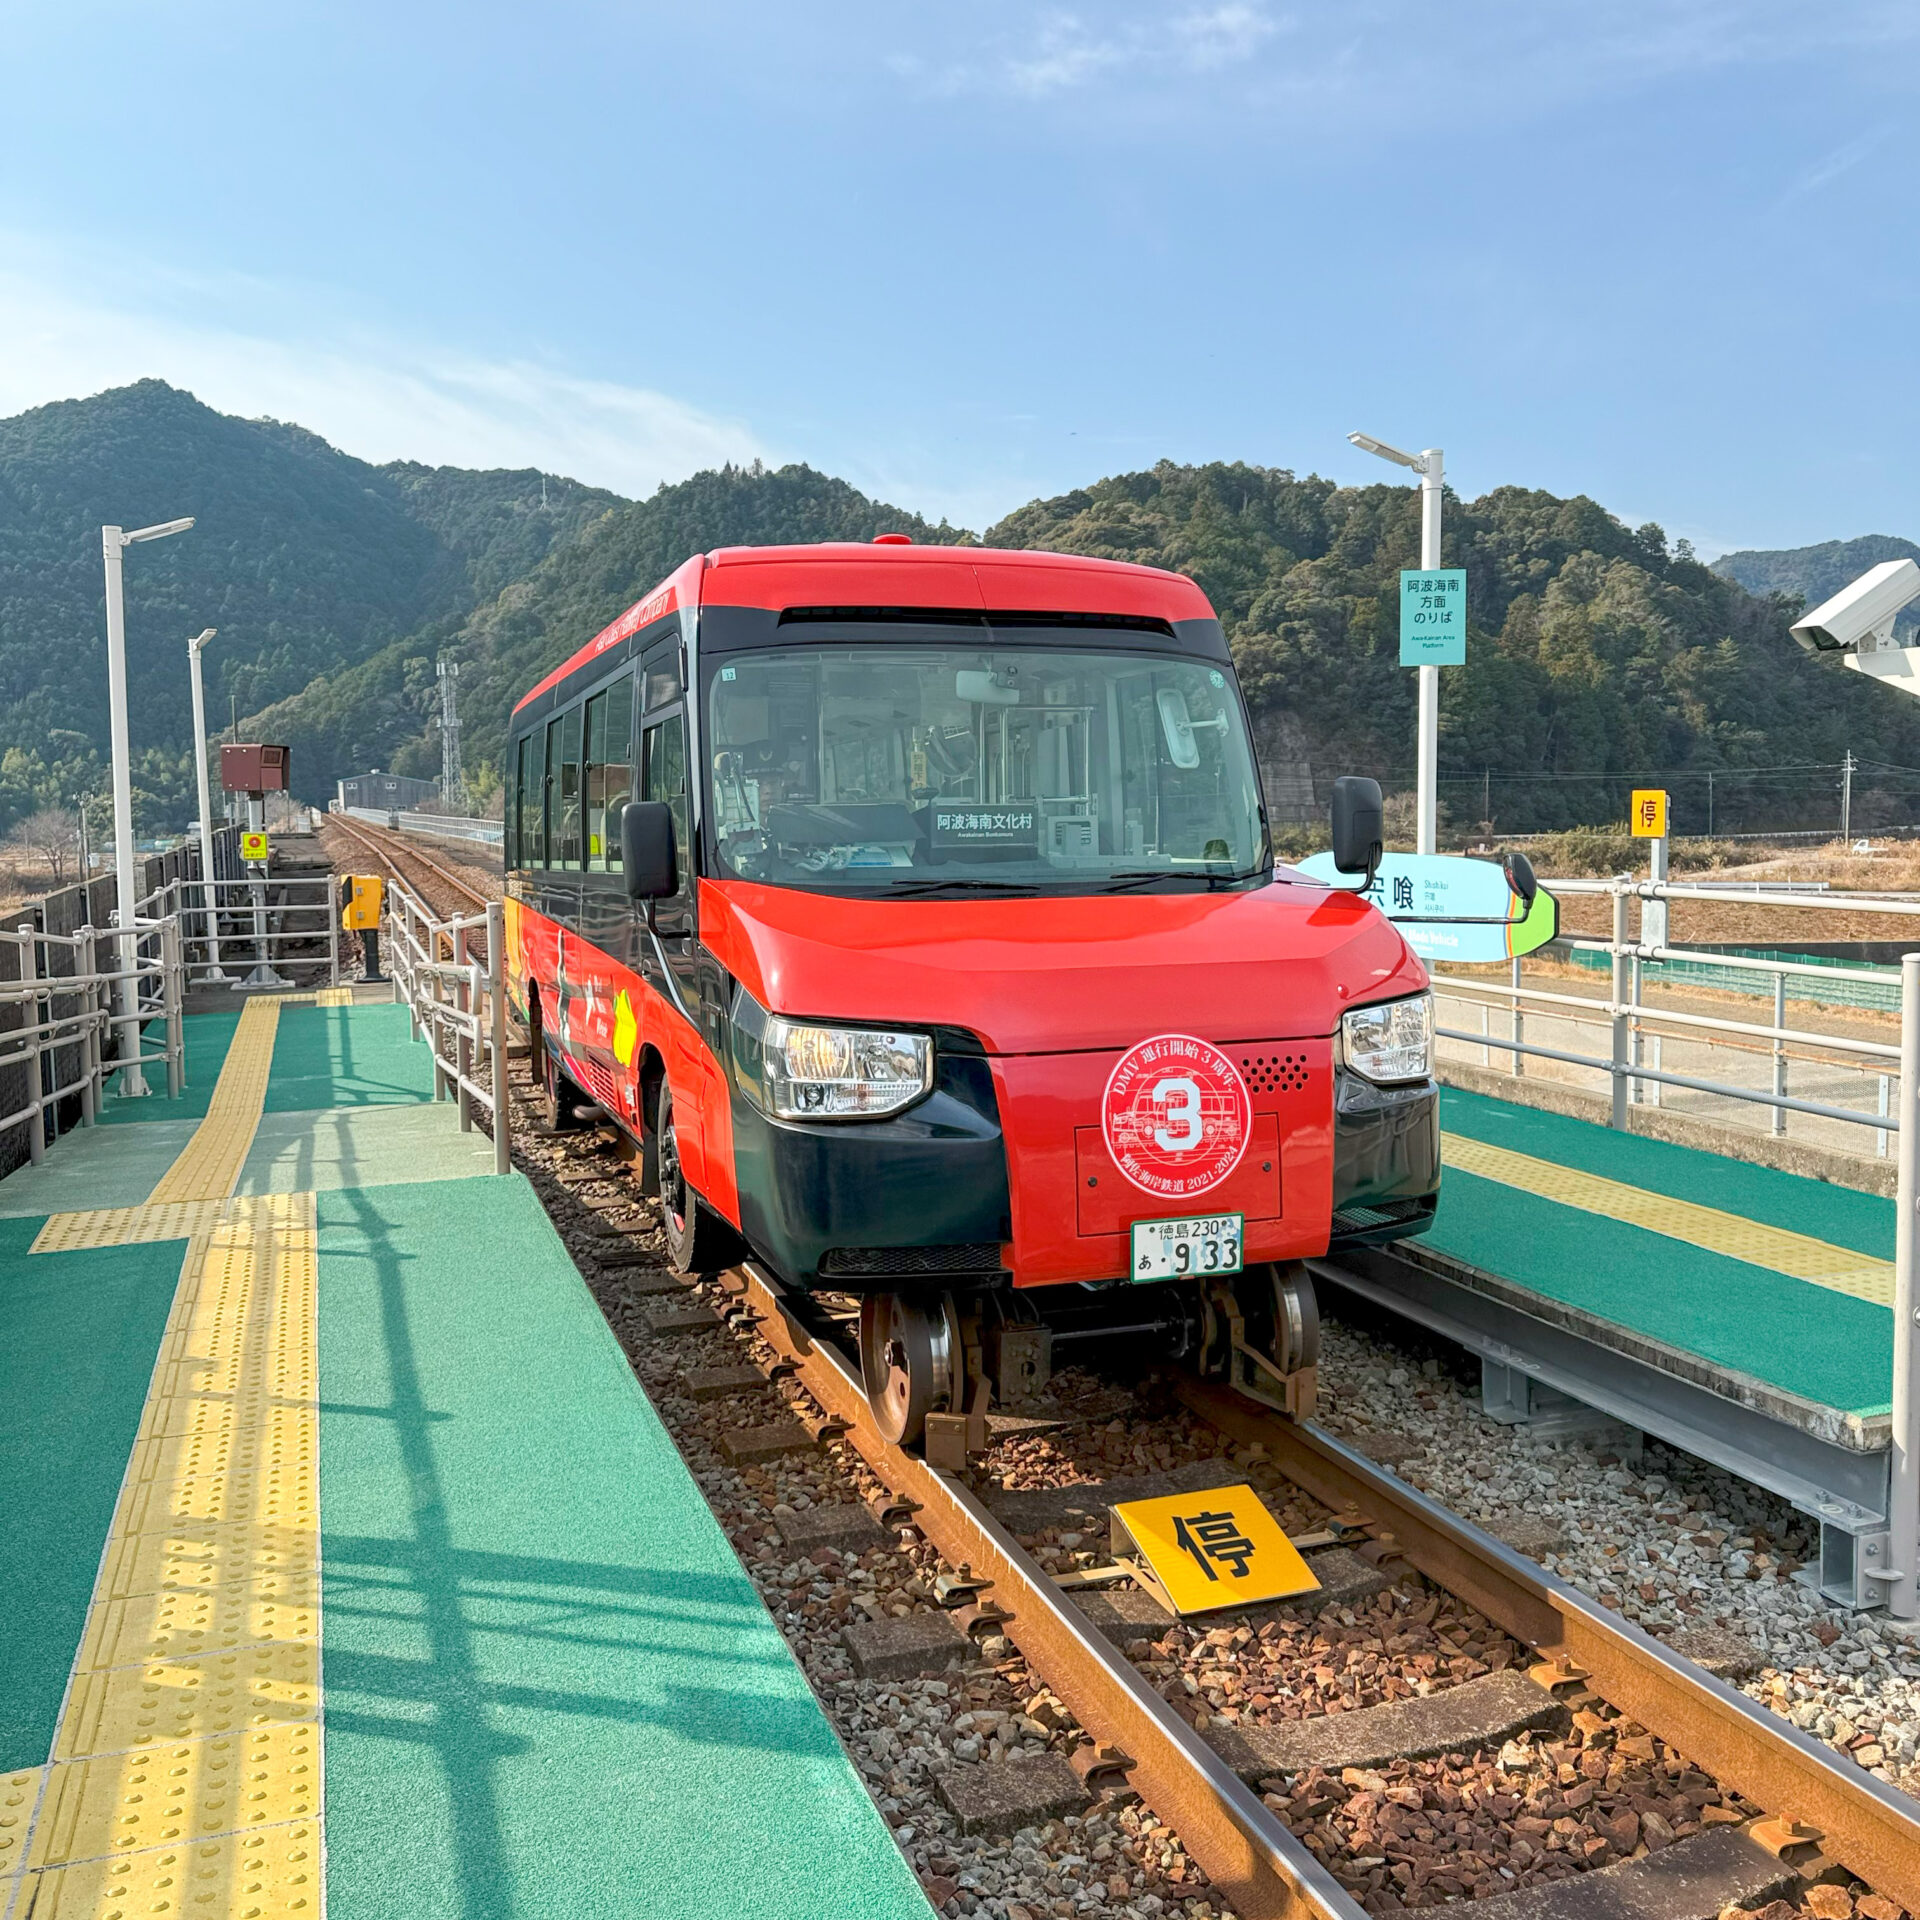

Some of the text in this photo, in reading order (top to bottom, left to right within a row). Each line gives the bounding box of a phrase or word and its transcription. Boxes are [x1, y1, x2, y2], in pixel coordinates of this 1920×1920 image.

[1407, 579, 1460, 593] 阿波海南
[1420, 595, 1446, 609] 方面
[1414, 611, 1453, 624] のりば
[937, 813, 1033, 830] 阿波海南文化村
[1639, 799, 1656, 828] 停
[1113, 1057, 1139, 1096] DMV
[1140, 1040, 1198, 1065] 運行開始
[1200, 1050, 1211, 1063] 3
[1152, 1076, 1203, 1151] 3
[1119, 1145, 1239, 1192] 阿佐海岸鉄道 2021-2024
[1171, 1510, 1257, 1582] 停
